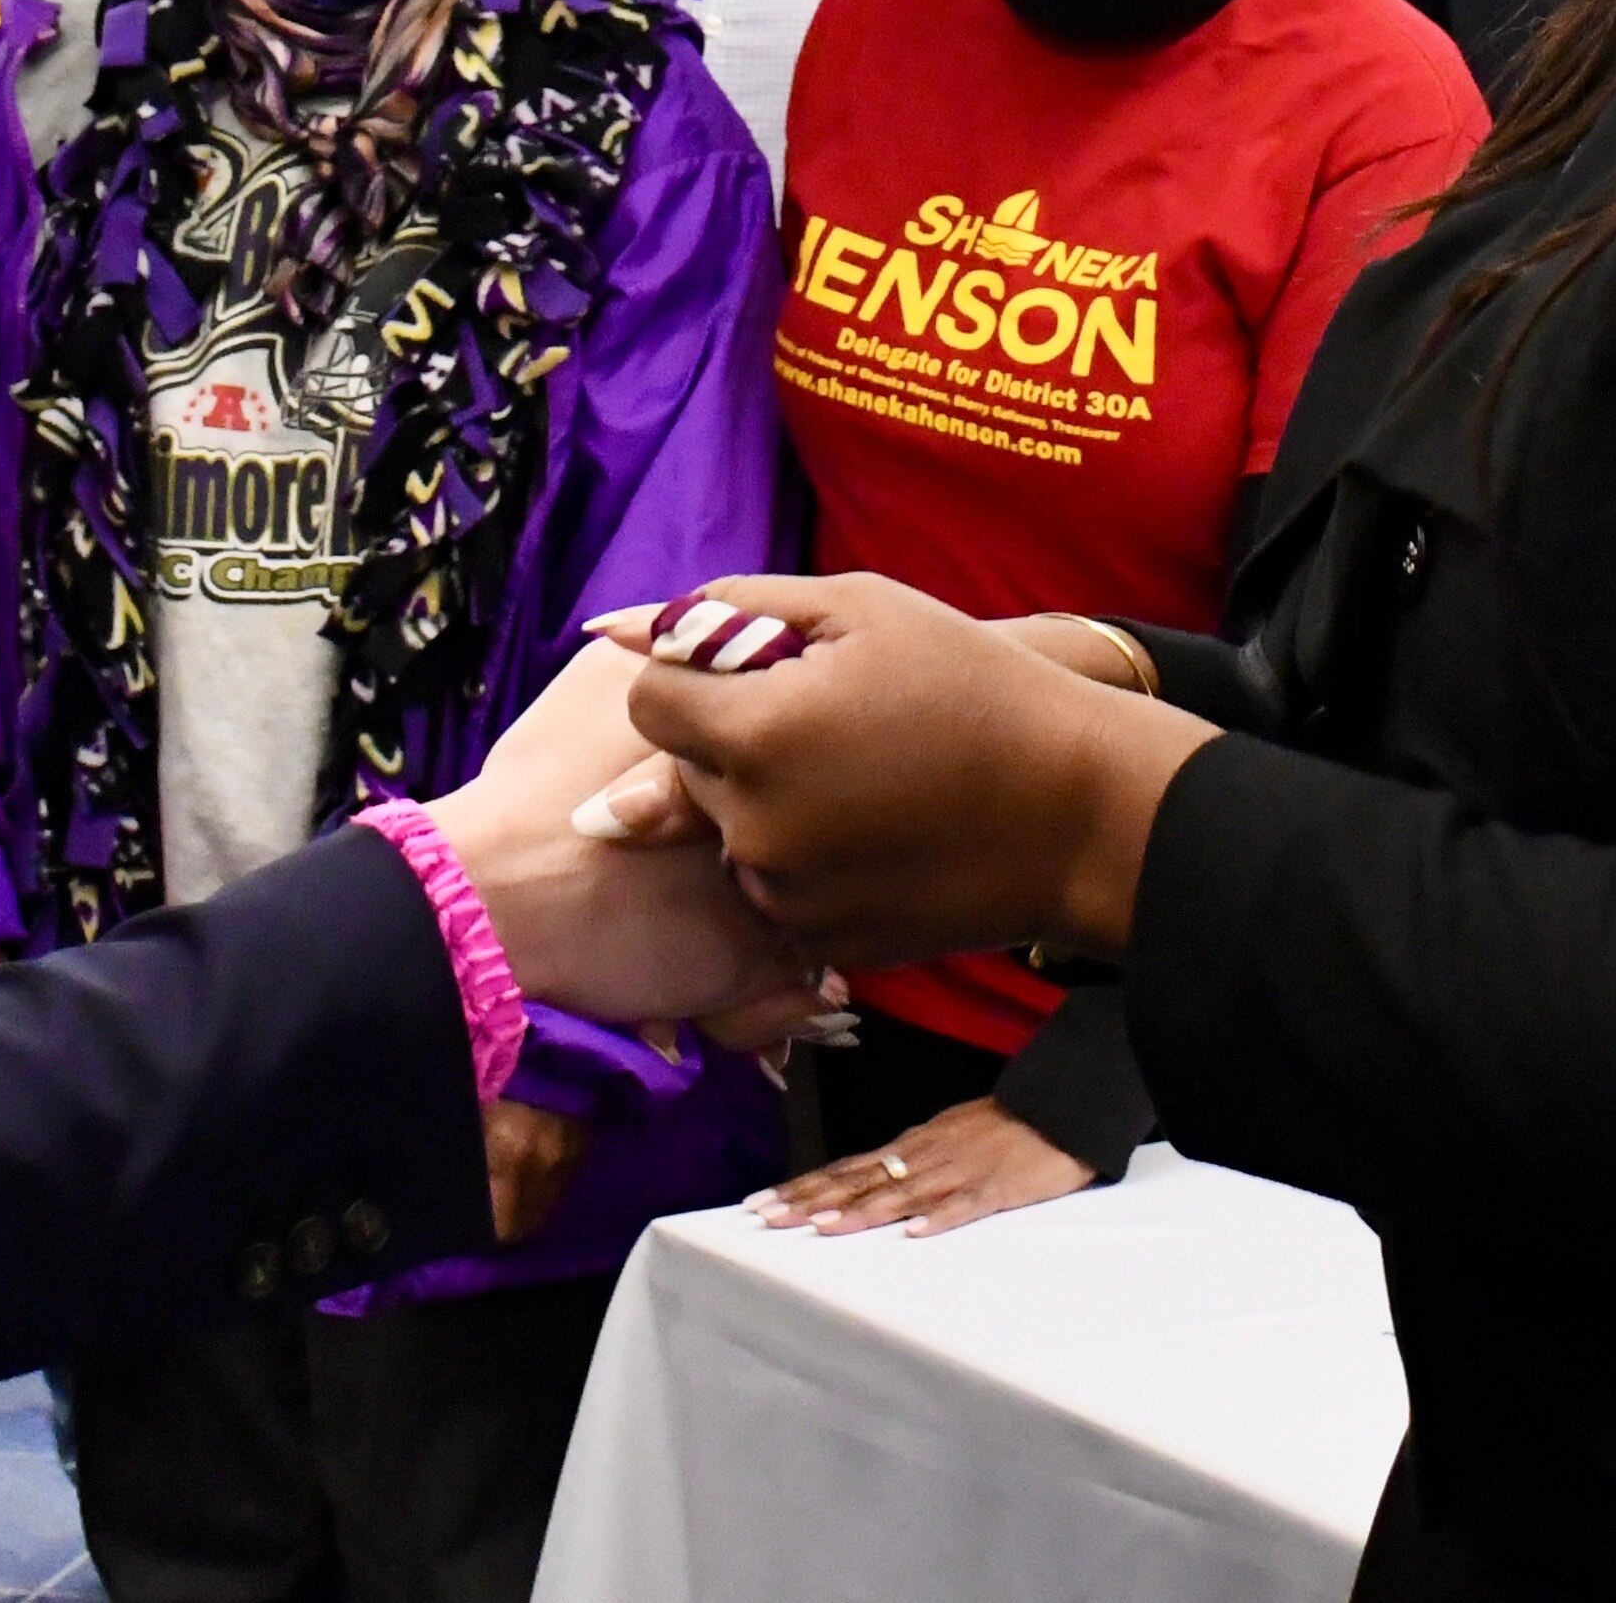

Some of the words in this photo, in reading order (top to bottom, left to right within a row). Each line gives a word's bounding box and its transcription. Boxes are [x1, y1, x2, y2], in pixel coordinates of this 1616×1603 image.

[836, 326, 943, 377] Delegate
[946, 358, 982, 387] for
[984, 368, 1078, 412] District
[1084, 390, 1153, 422] 30A
